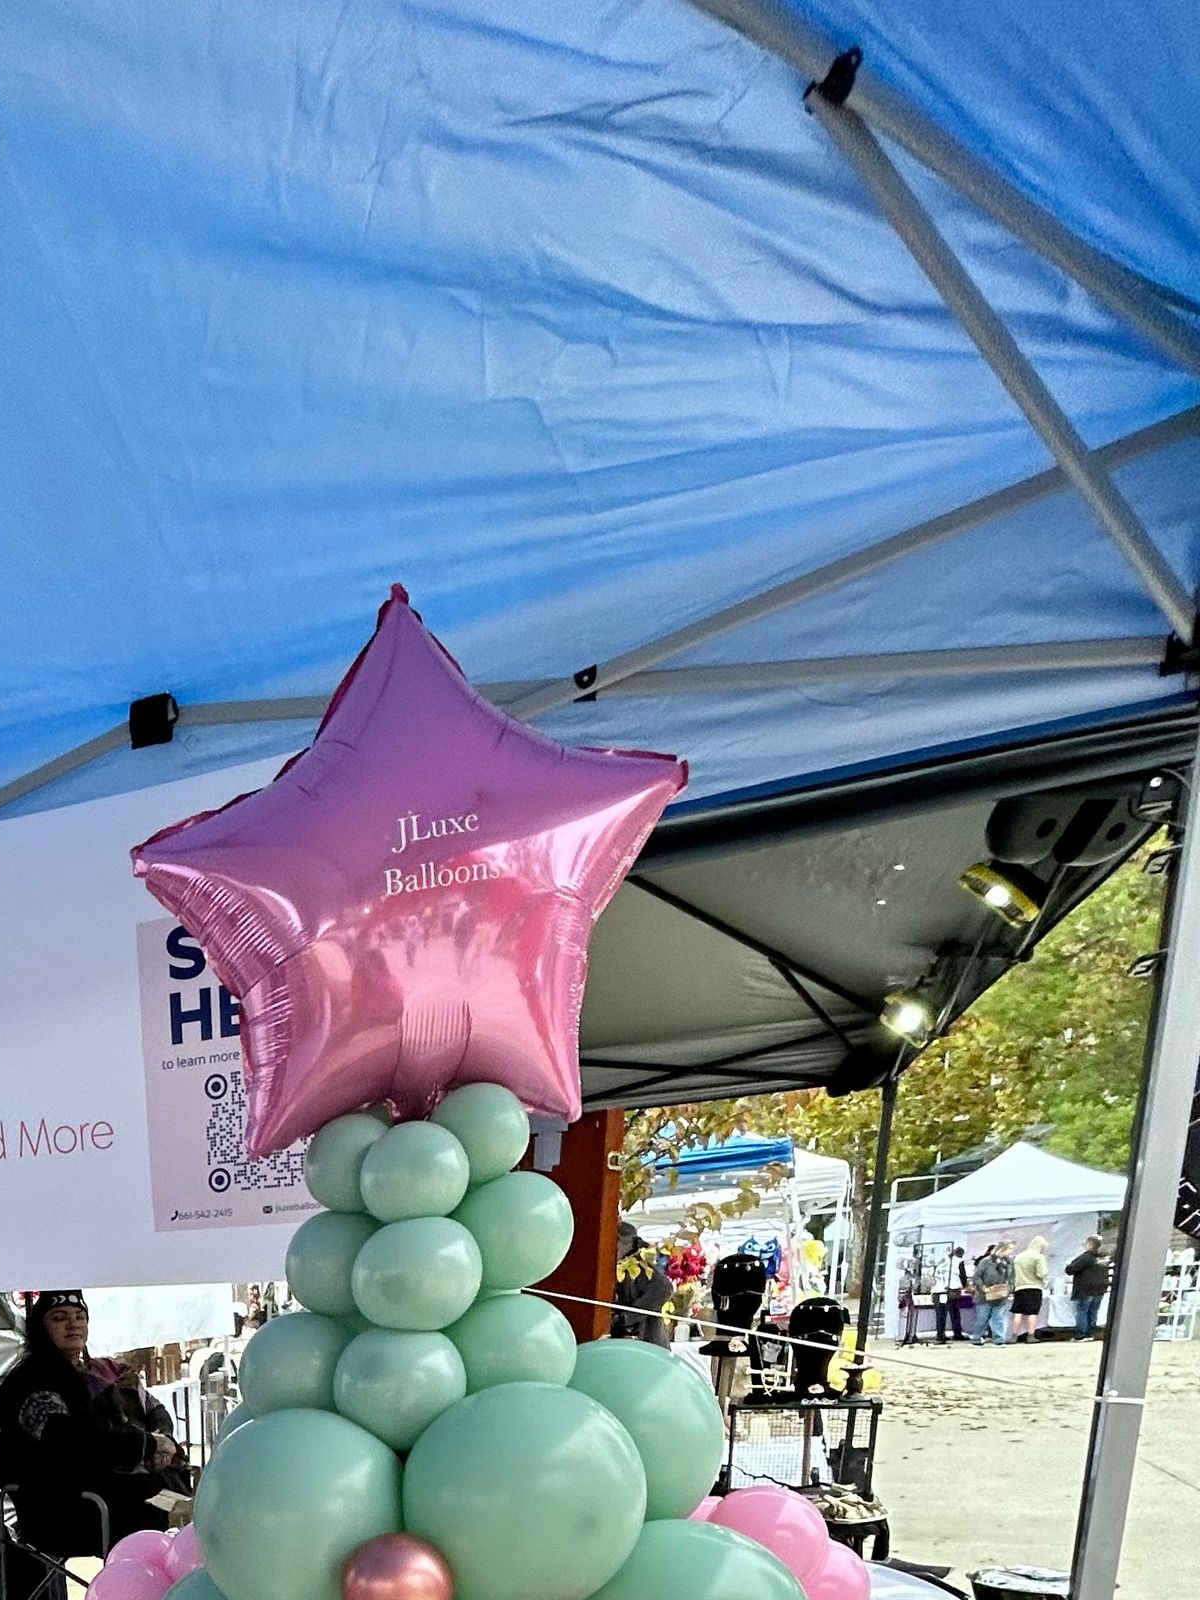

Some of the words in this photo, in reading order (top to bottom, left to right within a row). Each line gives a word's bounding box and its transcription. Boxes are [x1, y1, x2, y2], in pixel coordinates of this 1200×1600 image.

[391, 812, 480, 854] JLuxe
[383, 859, 501, 896] Balloons
[169, 984, 242, 1045] HE
[162, 1060, 174, 1070] to
[176, 1056, 206, 1068] learn
[209, 1051, 241, 1063] more
[18, 1118, 115, 1158] More
